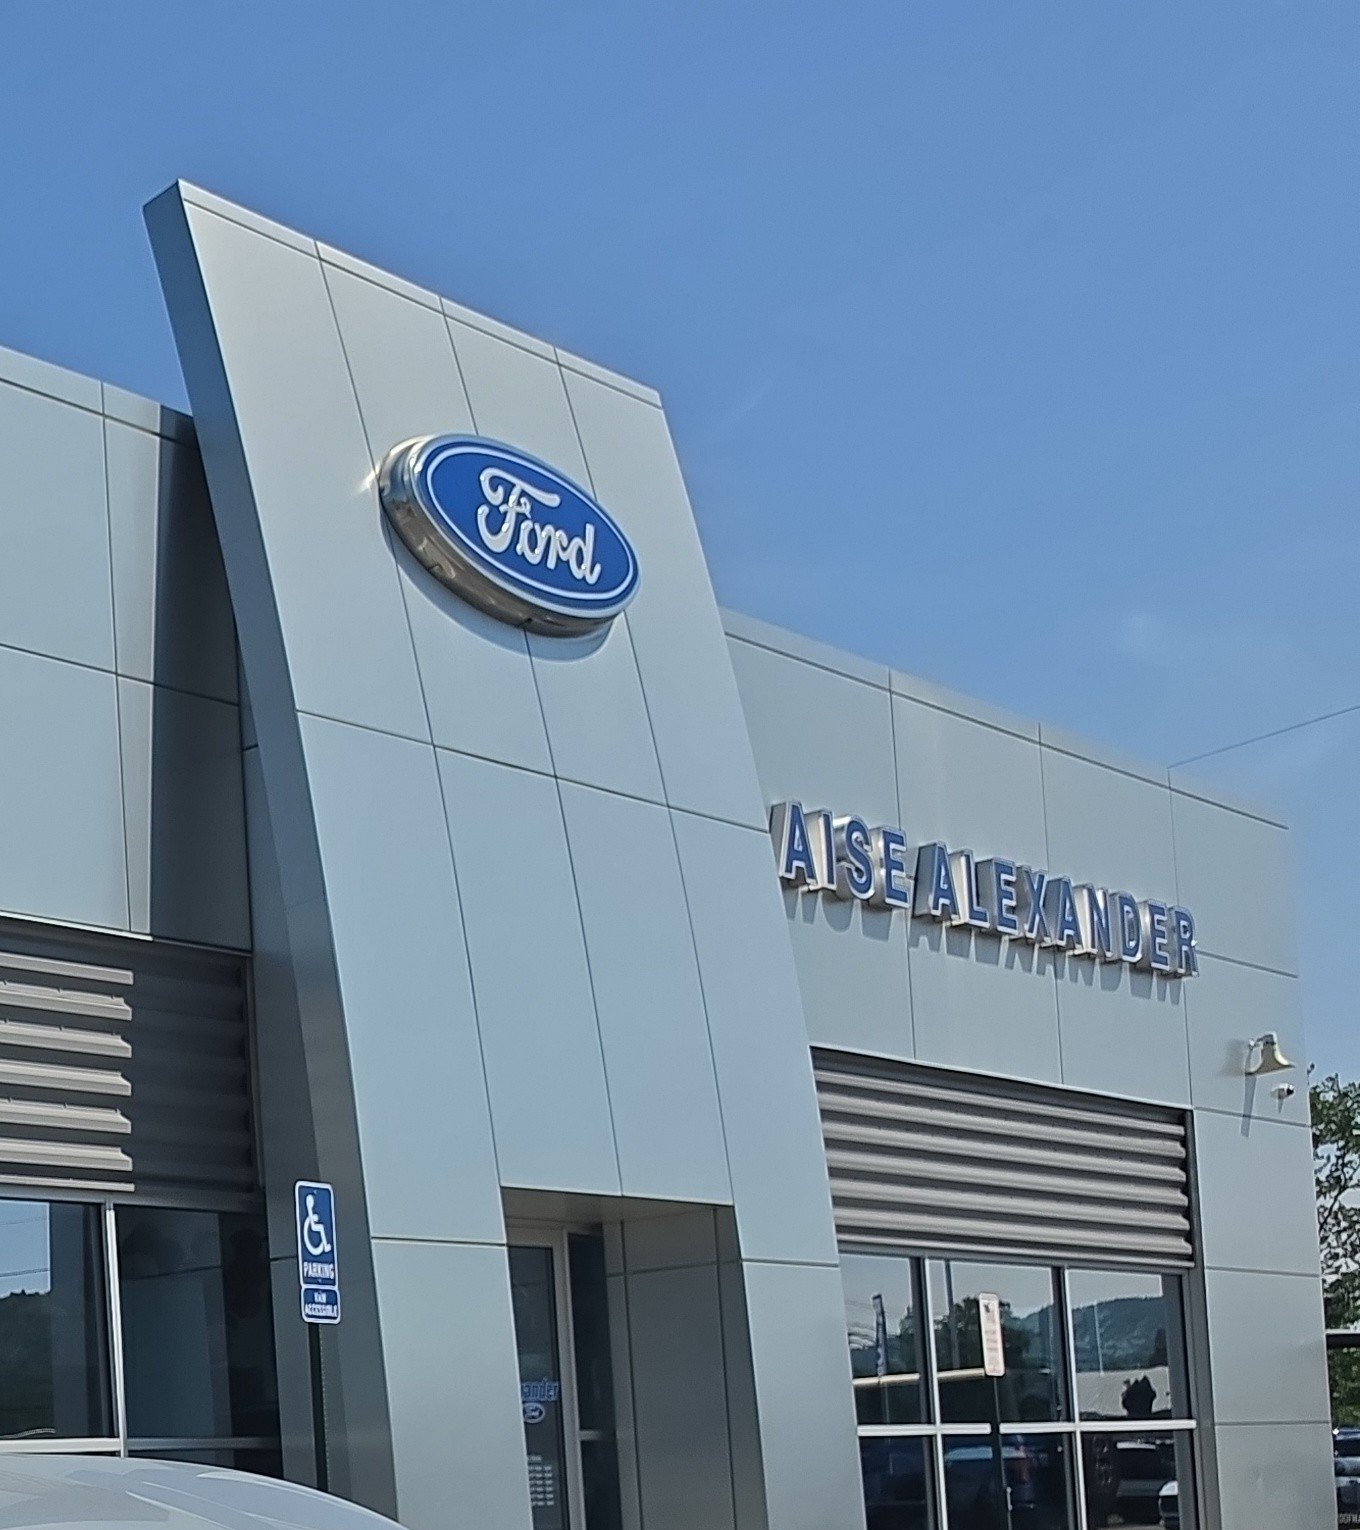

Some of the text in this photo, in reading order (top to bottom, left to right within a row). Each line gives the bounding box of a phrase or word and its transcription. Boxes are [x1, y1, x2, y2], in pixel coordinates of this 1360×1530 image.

[476, 466, 603, 586] Ford
[913, 840, 1200, 979] ALEXANDER
[303, 1261, 335, 1280] PARKING
